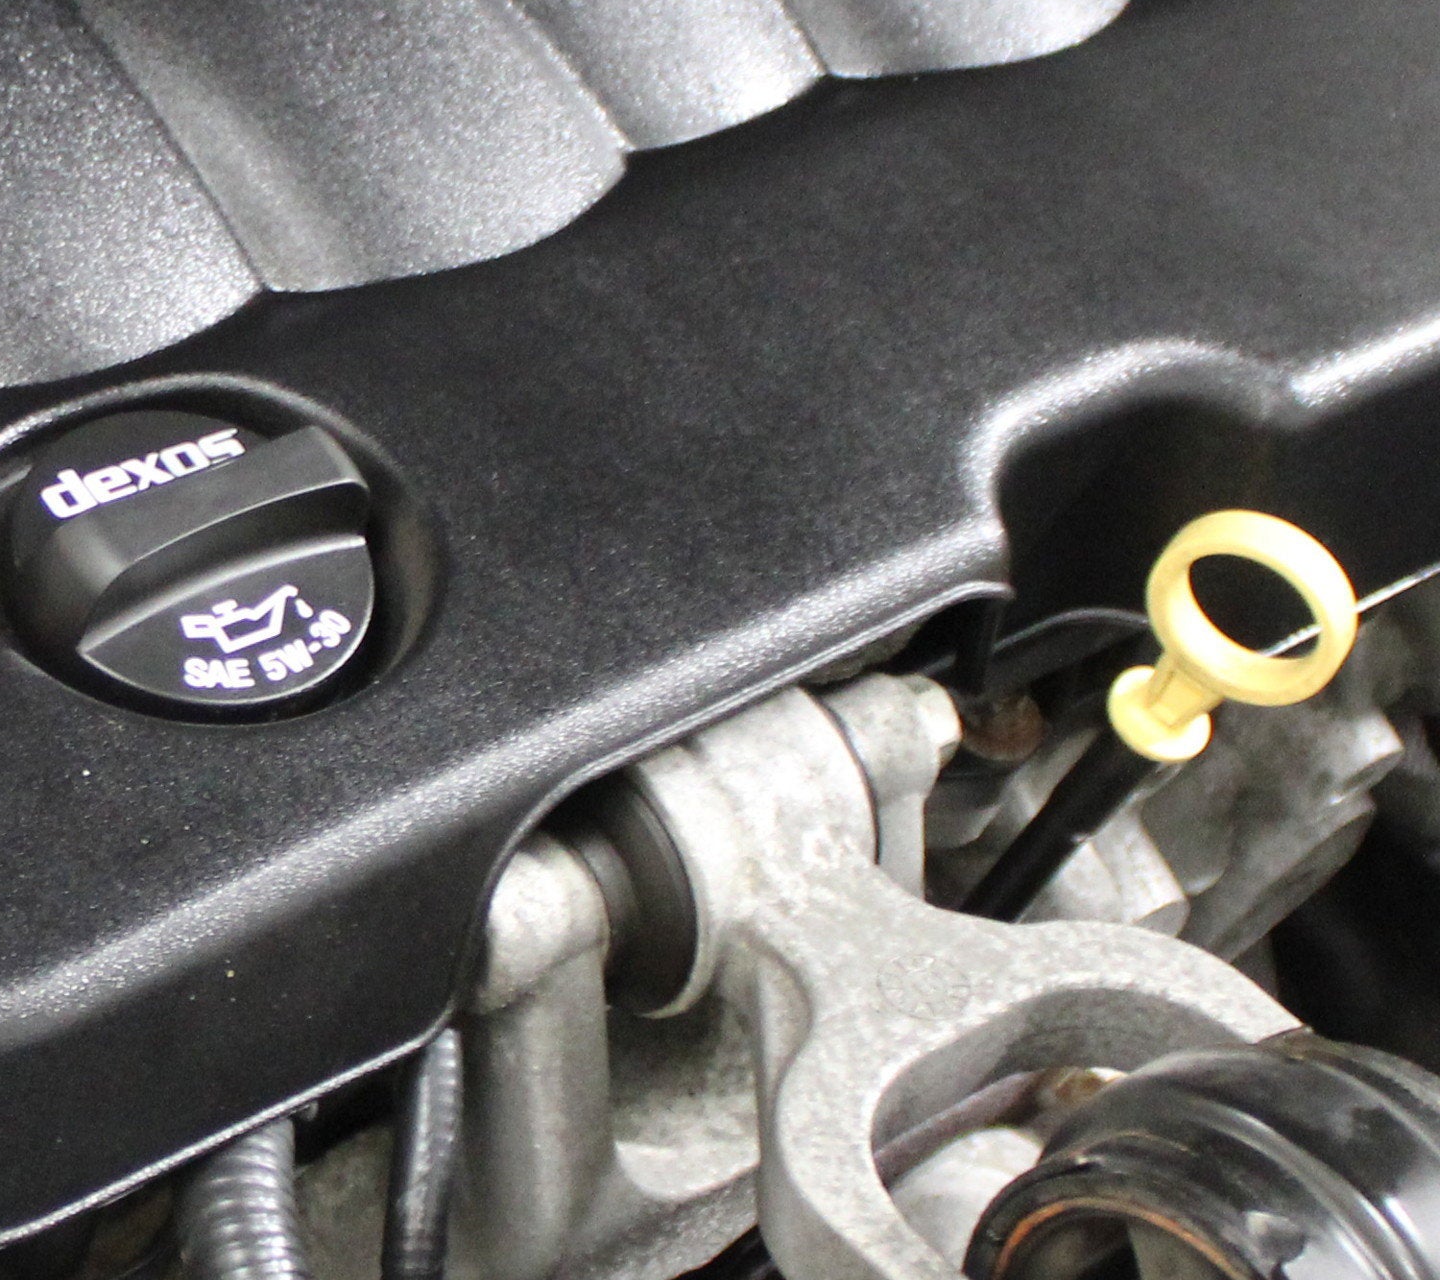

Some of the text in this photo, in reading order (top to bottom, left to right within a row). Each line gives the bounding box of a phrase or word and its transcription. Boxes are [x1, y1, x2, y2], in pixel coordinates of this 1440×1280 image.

[39, 428, 247, 520] dexos
[182, 608, 353, 690] SAE 5W-30
